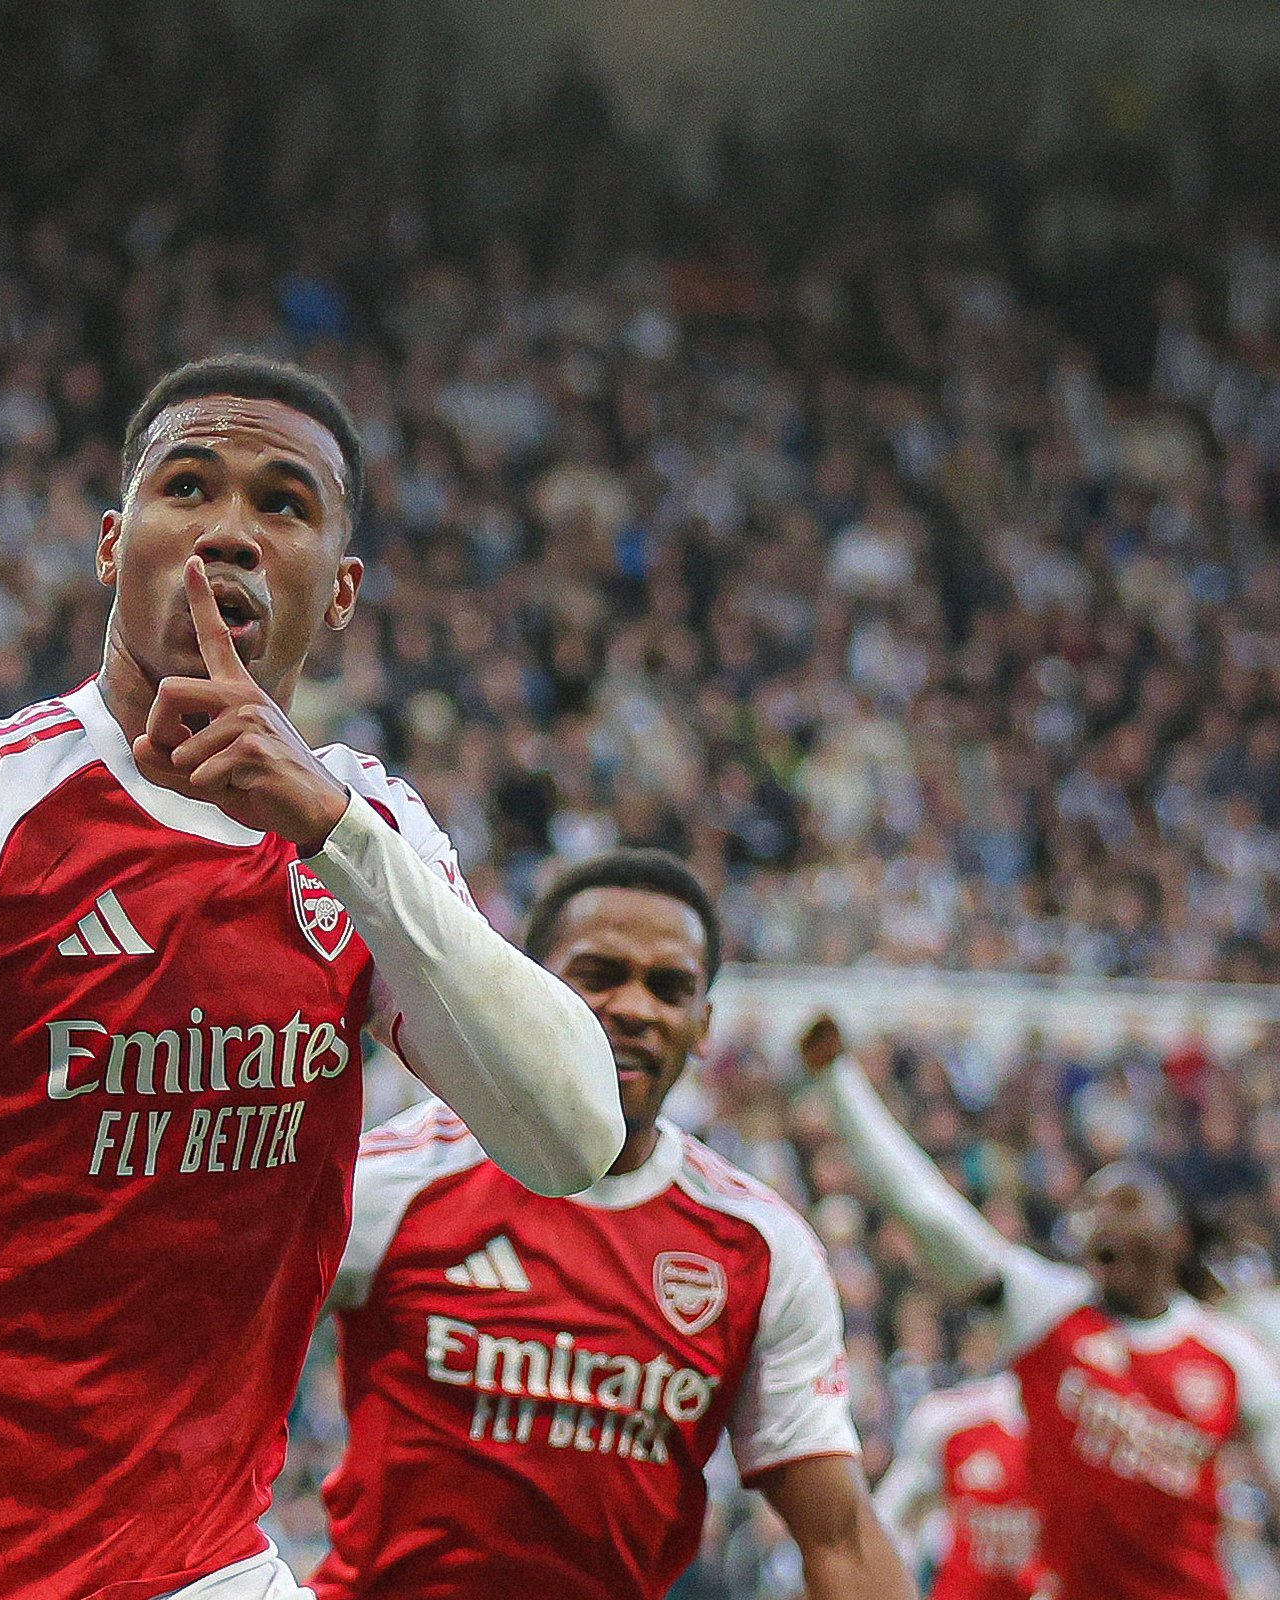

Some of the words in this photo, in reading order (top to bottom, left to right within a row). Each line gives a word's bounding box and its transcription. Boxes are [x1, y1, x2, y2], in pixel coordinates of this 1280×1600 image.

[46, 1007, 350, 1100] Emirates
[89, 1110, 172, 1176] FLY
[180, 1100, 305, 1174] BETTER
